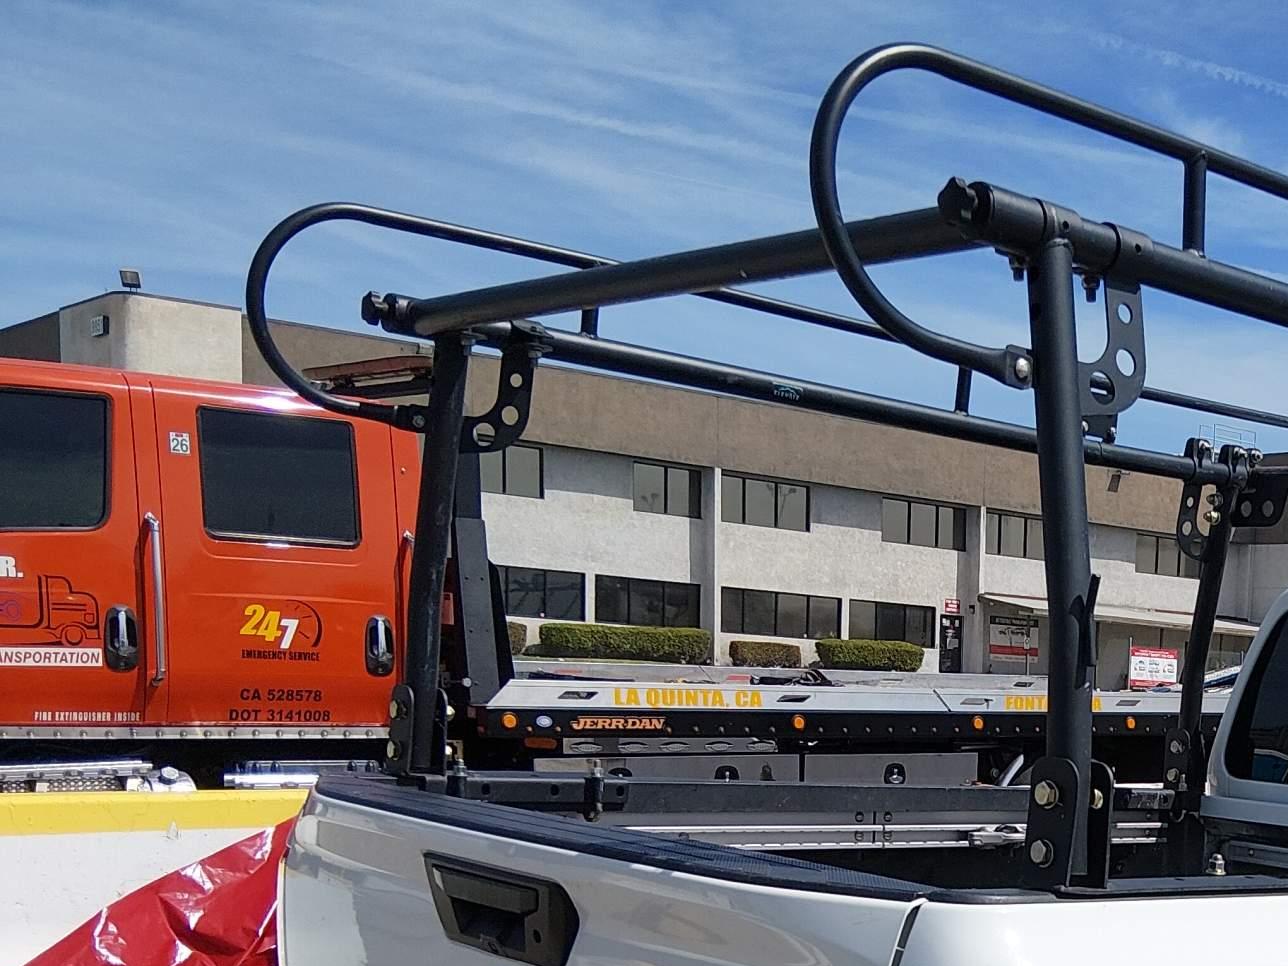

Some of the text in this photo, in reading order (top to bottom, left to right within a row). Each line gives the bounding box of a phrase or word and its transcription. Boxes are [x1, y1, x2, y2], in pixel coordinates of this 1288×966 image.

[172, 437, 189, 452] 26
[242, 649, 319, 661] EMERGENCY SERVICE
[240, 688, 322, 702] CA 528578
[614, 688, 763, 707] LA QUINTA, CA
[1005, 695, 1102, 711] FONTA
[34, 711, 141, 722] FIRE EXTINGUISHER INSIDE
[229, 709, 331, 722] DOT 3141008
